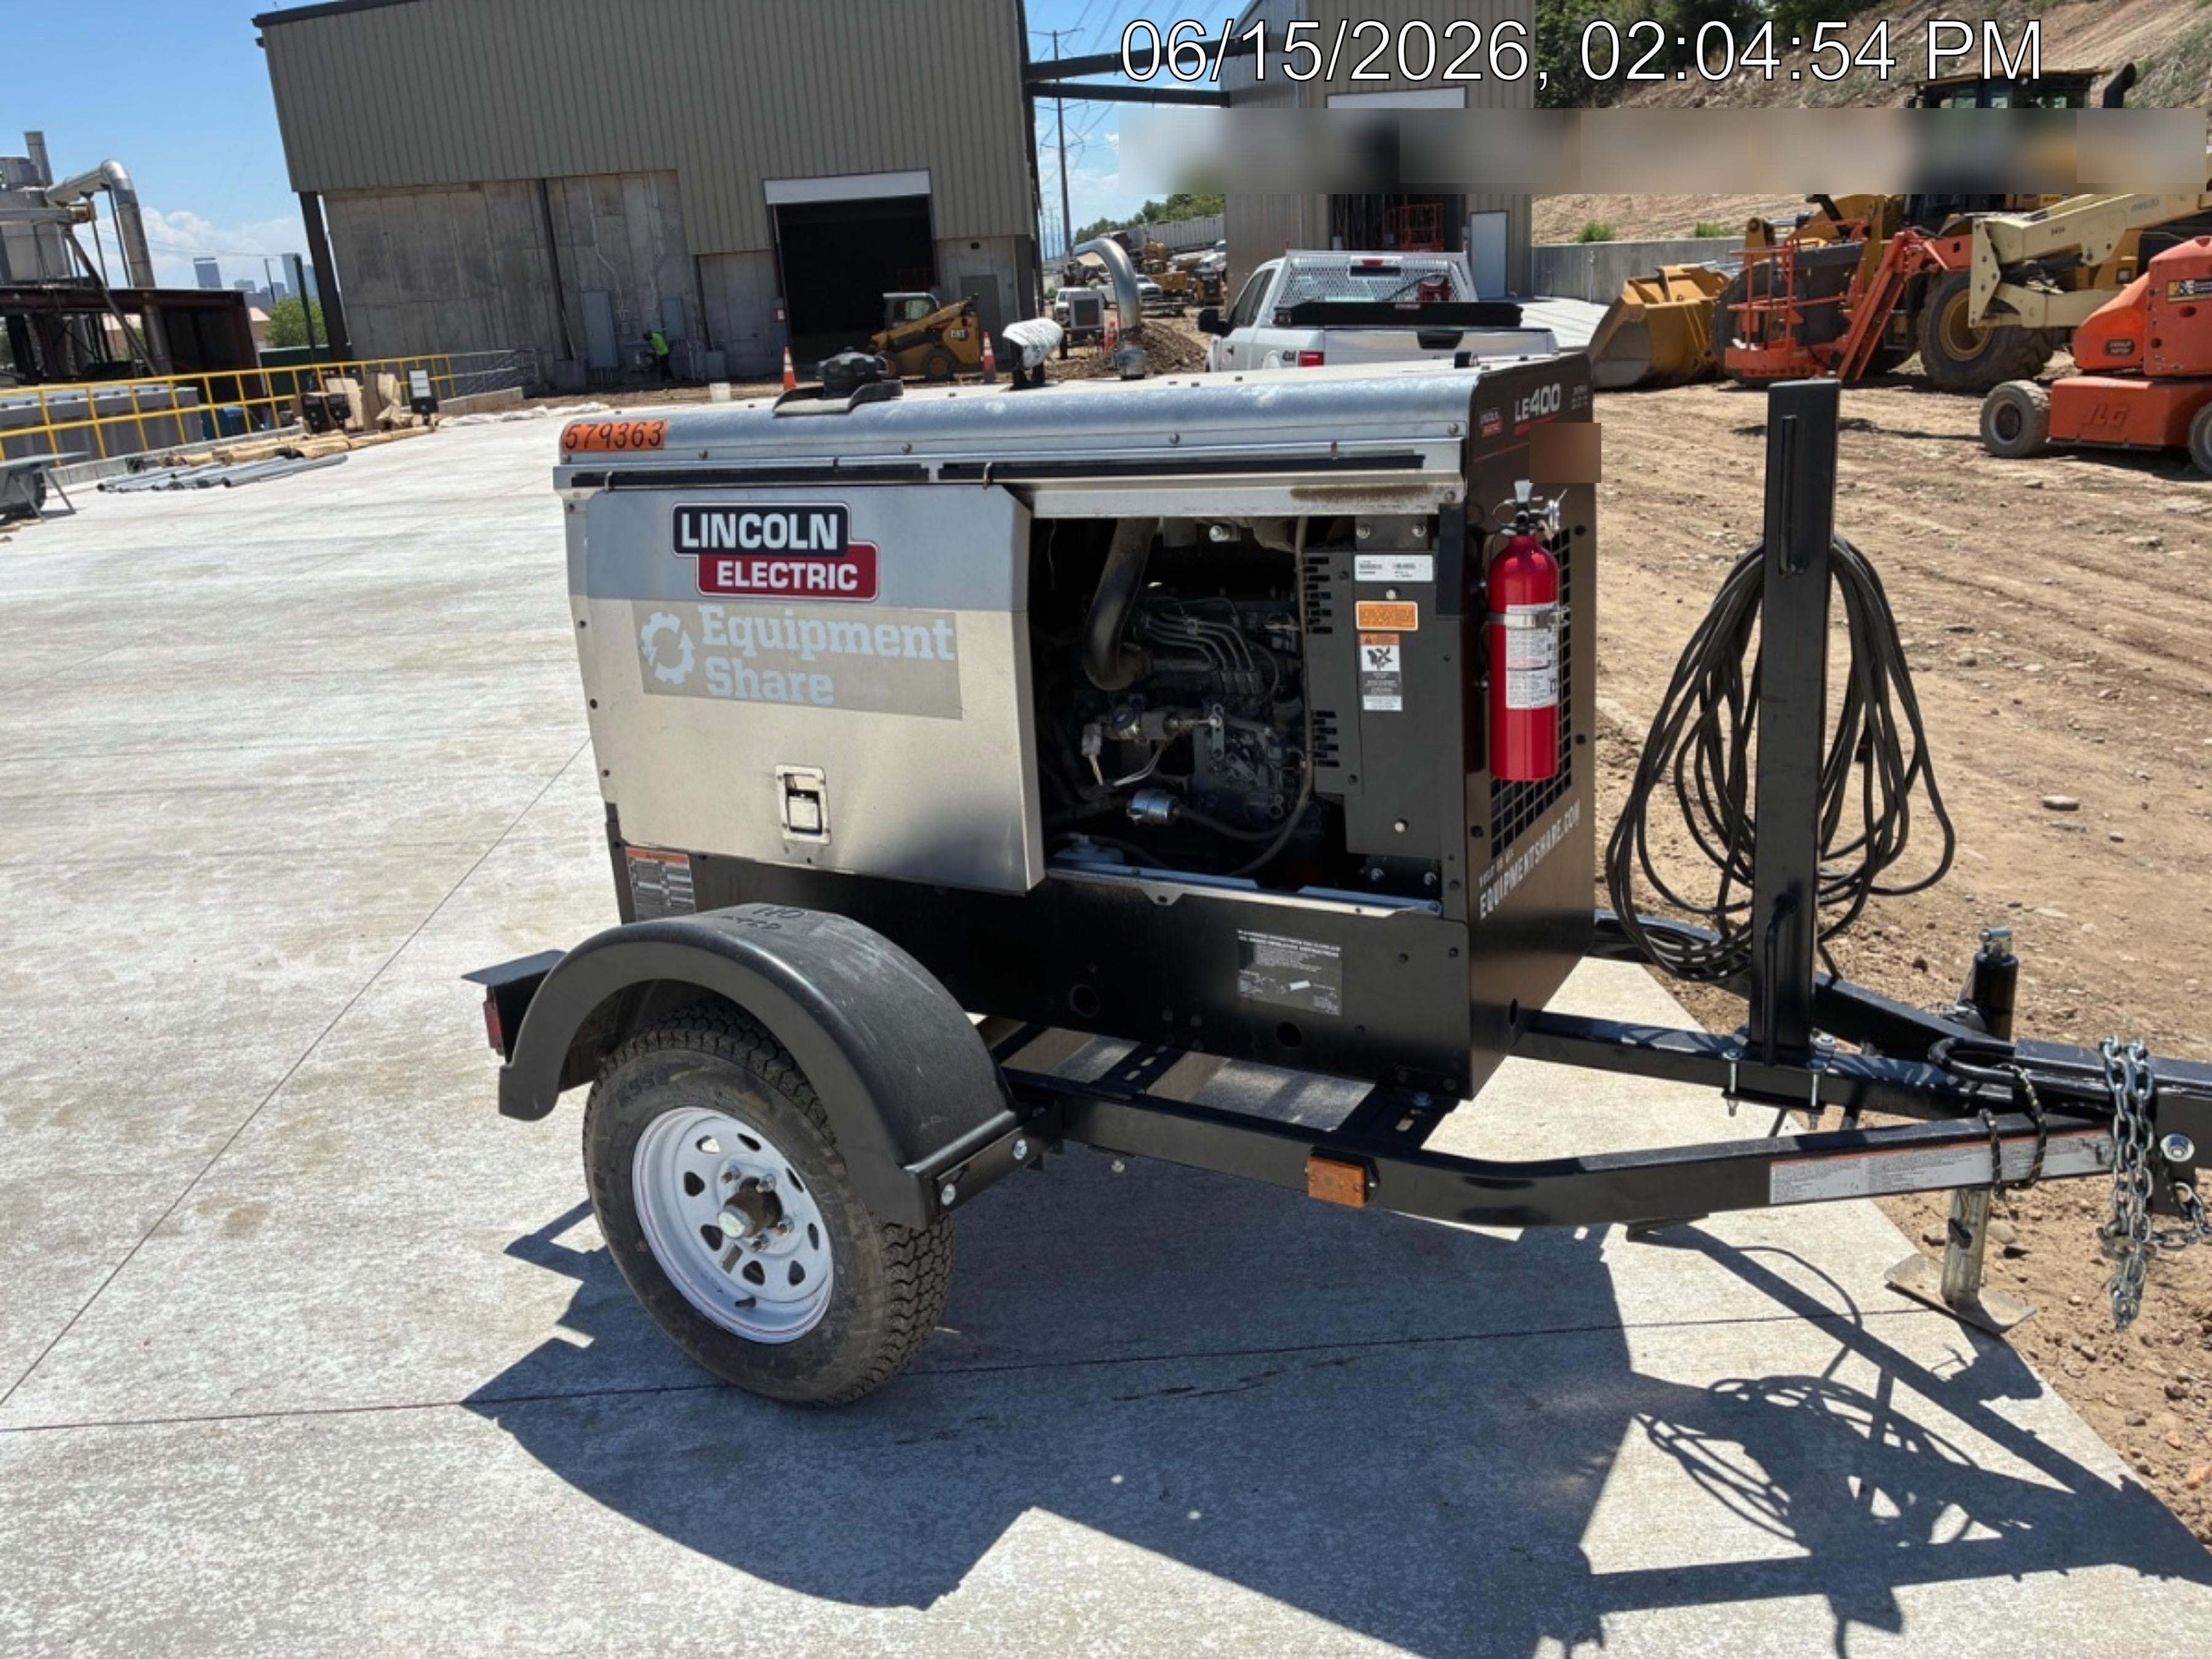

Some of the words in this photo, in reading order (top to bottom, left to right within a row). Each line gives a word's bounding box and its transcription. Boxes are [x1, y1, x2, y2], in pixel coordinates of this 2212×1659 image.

[1515, 383, 1561, 423] LE400
[564, 419, 665, 450] 579363
[681, 512, 839, 551] LINCOLN
[716, 560, 859, 591] ELECTRIC
[698, 605, 955, 662] Equipment
[704, 657, 834, 705] Share
[1479, 797, 1582, 921] EQUIPMENTSHARE.COM
